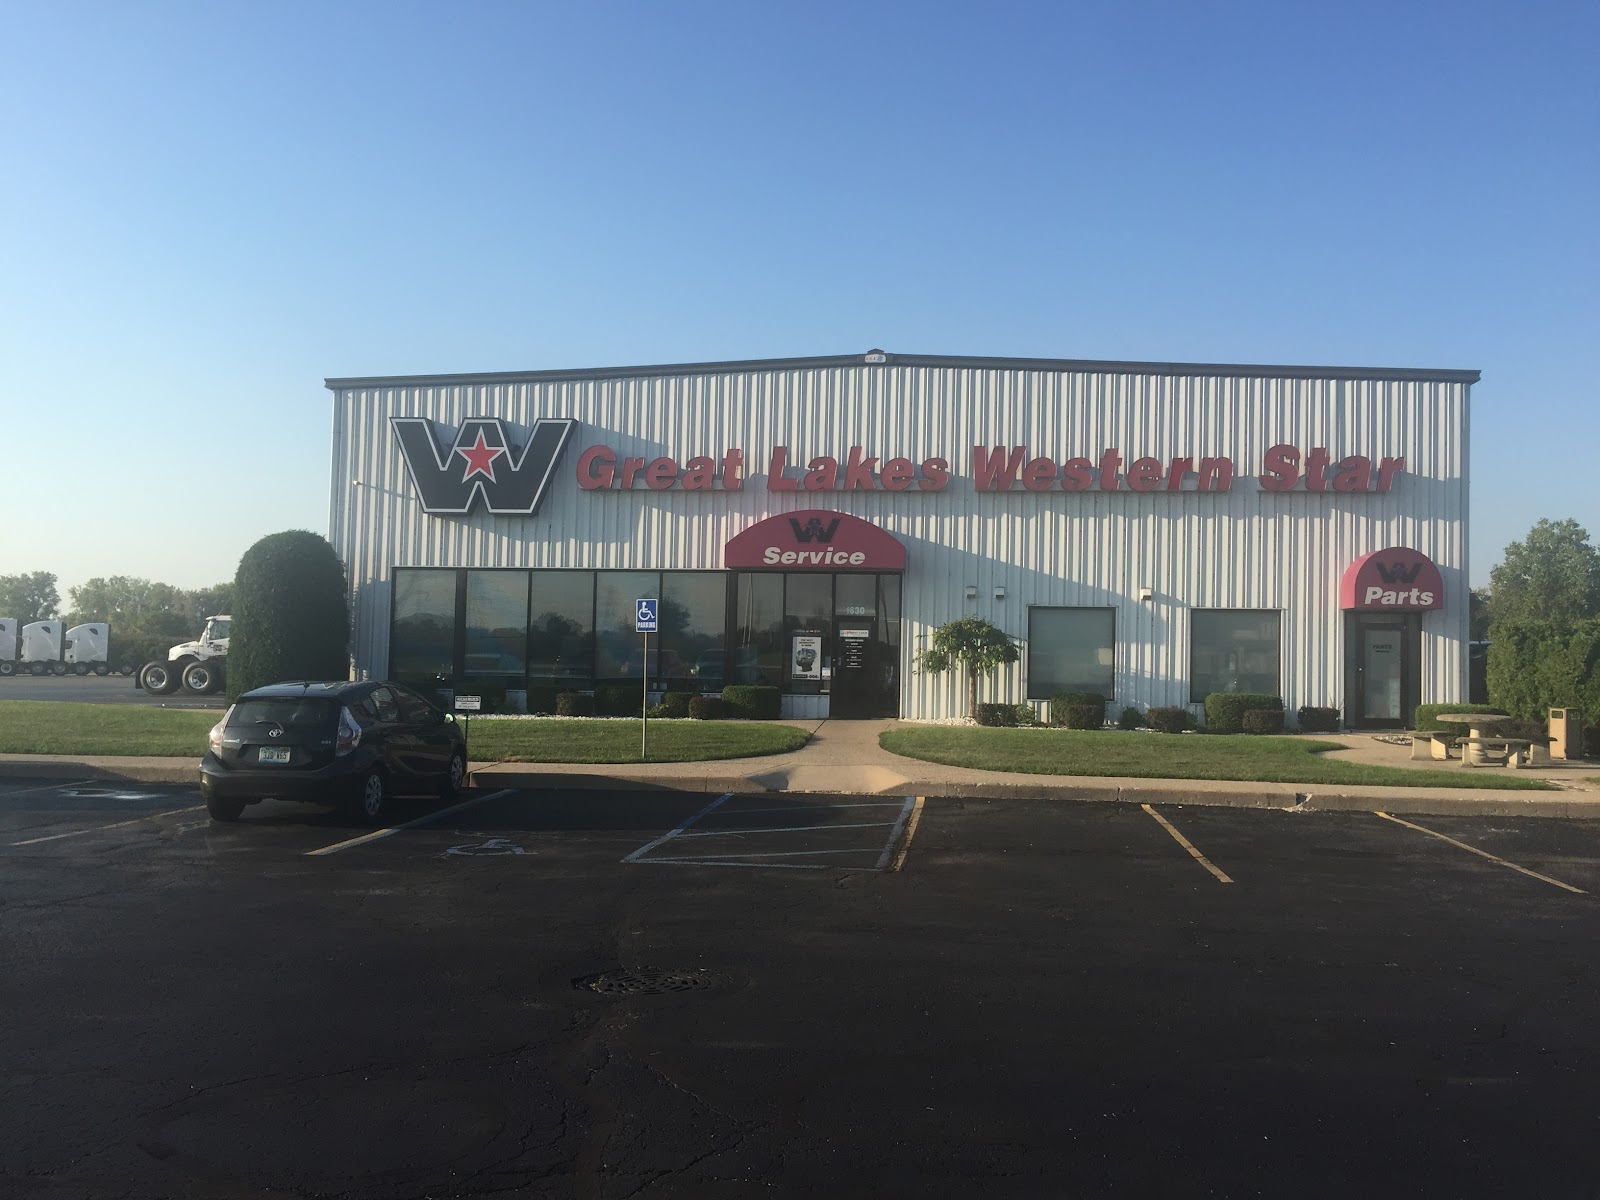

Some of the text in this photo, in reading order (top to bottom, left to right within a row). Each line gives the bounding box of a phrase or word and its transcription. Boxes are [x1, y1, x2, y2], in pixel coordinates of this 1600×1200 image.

[576, 444, 1405, 492] Great Lakes Western Star
[763, 547, 866, 566] Service
[1364, 586, 1434, 606] Parts
[846, 606, 865, 615] 1630
